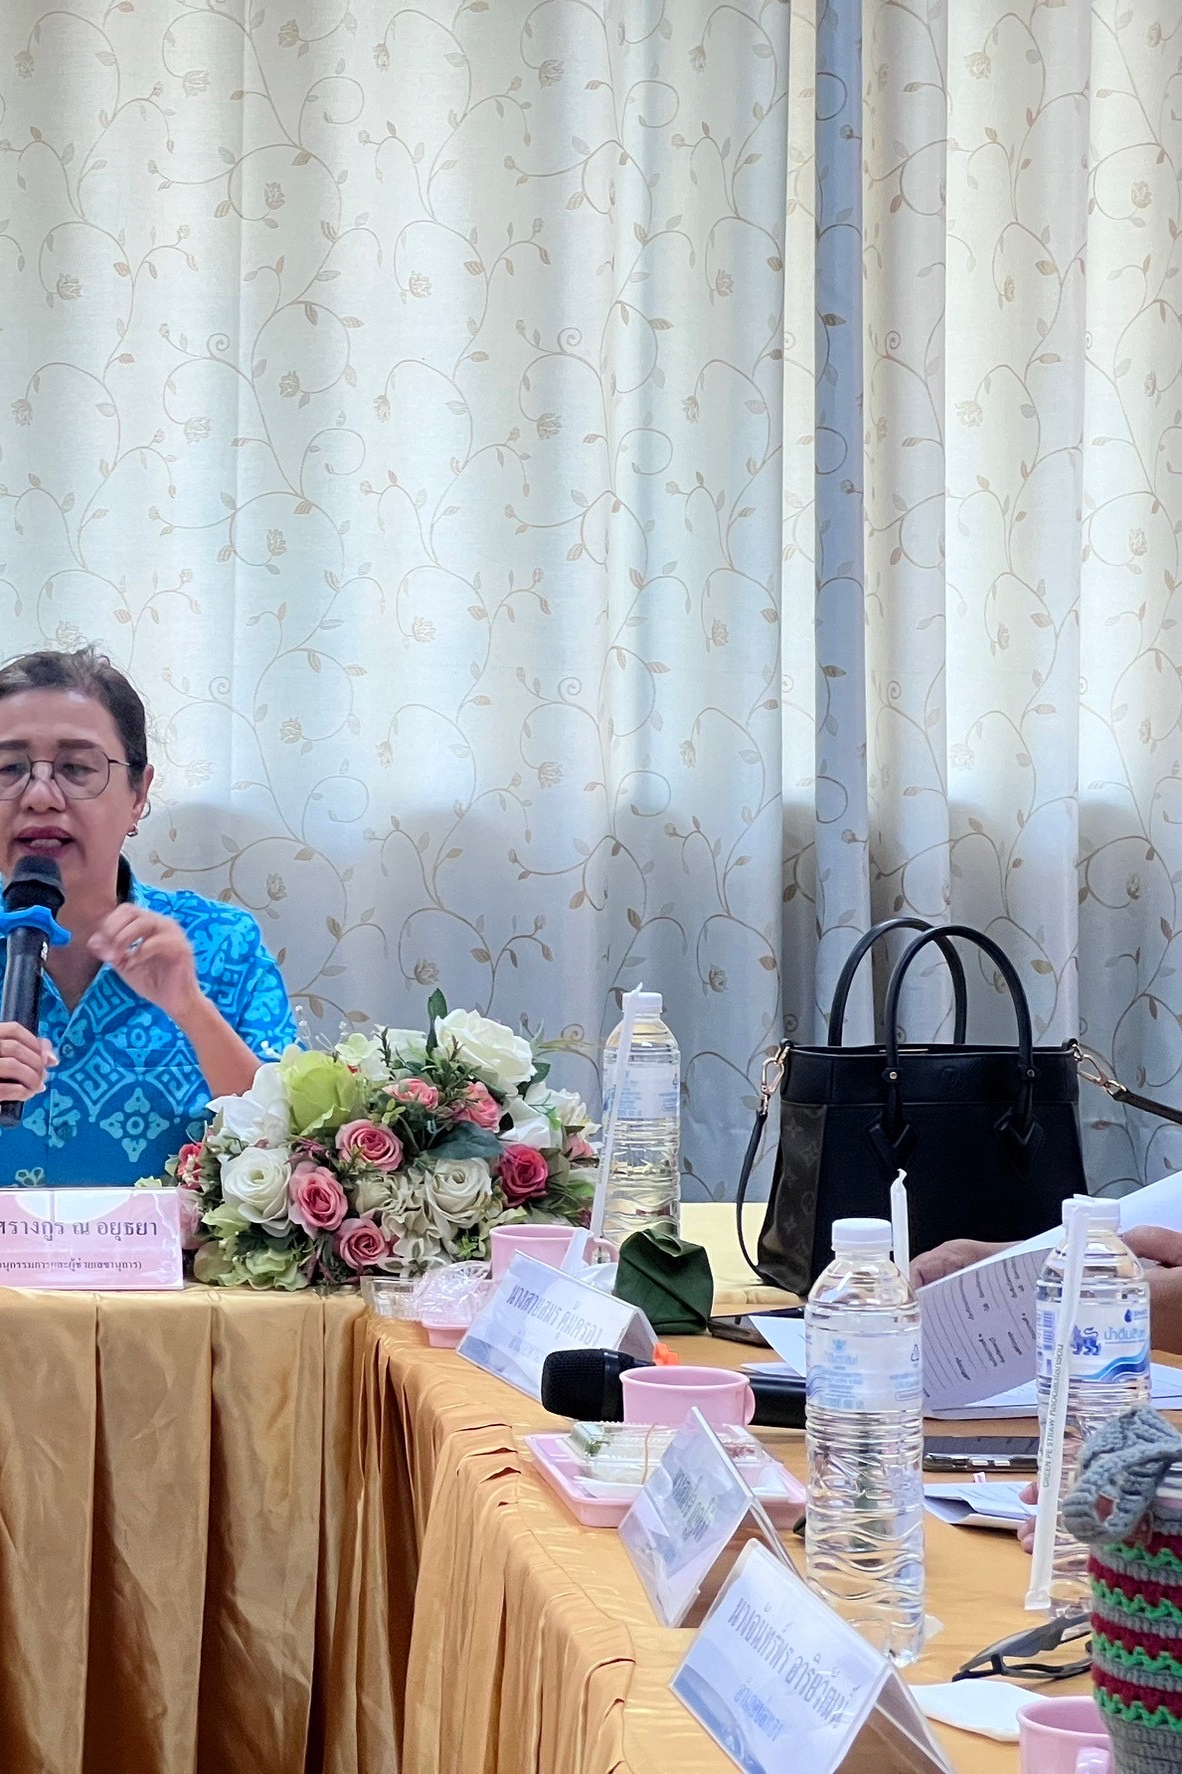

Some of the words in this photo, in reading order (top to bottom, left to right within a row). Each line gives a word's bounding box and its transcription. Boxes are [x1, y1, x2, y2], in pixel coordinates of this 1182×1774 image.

[72, 1220, 90, 1236] ณ
[97, 1221, 158, 1242] อยุธยา
[1047, 1418, 1055, 1447] STRAW
